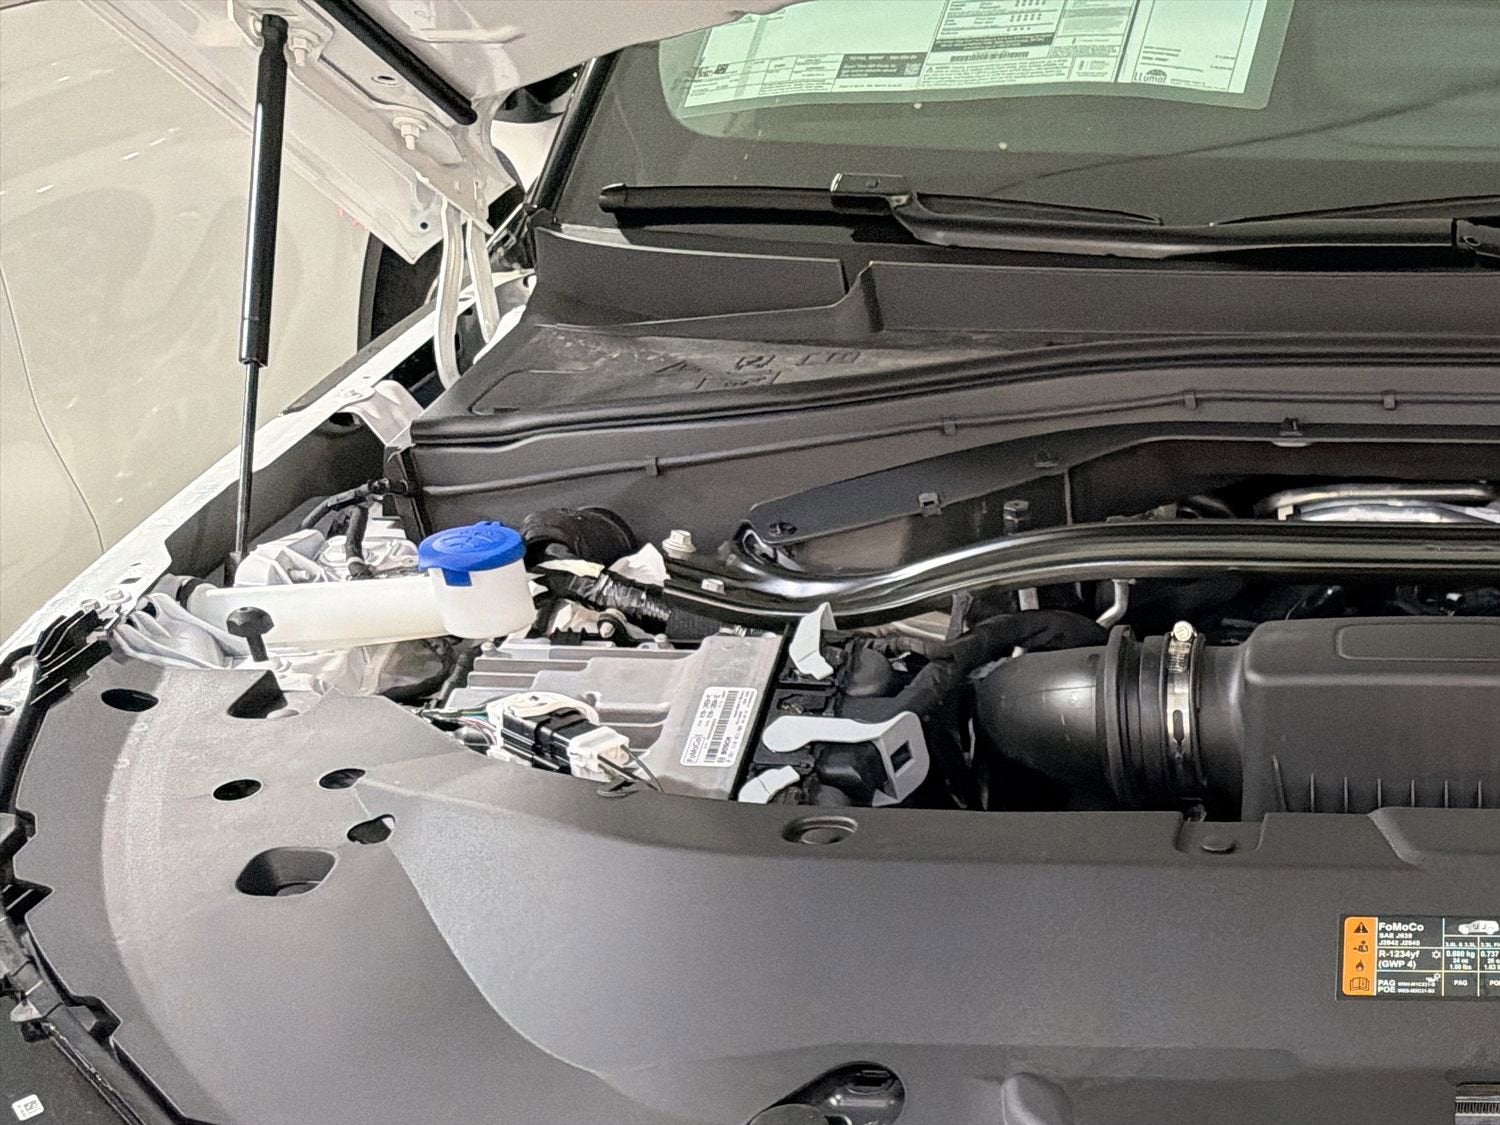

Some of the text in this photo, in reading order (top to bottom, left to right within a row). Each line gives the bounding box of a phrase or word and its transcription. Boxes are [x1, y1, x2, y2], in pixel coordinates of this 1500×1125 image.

[1378, 922, 1424, 932] FoMoCo
[1378, 950, 1420, 960] R-1234yf
[1466, 950, 1475, 959] kg
[1378, 960, 1416, 969] (GWP 4)
